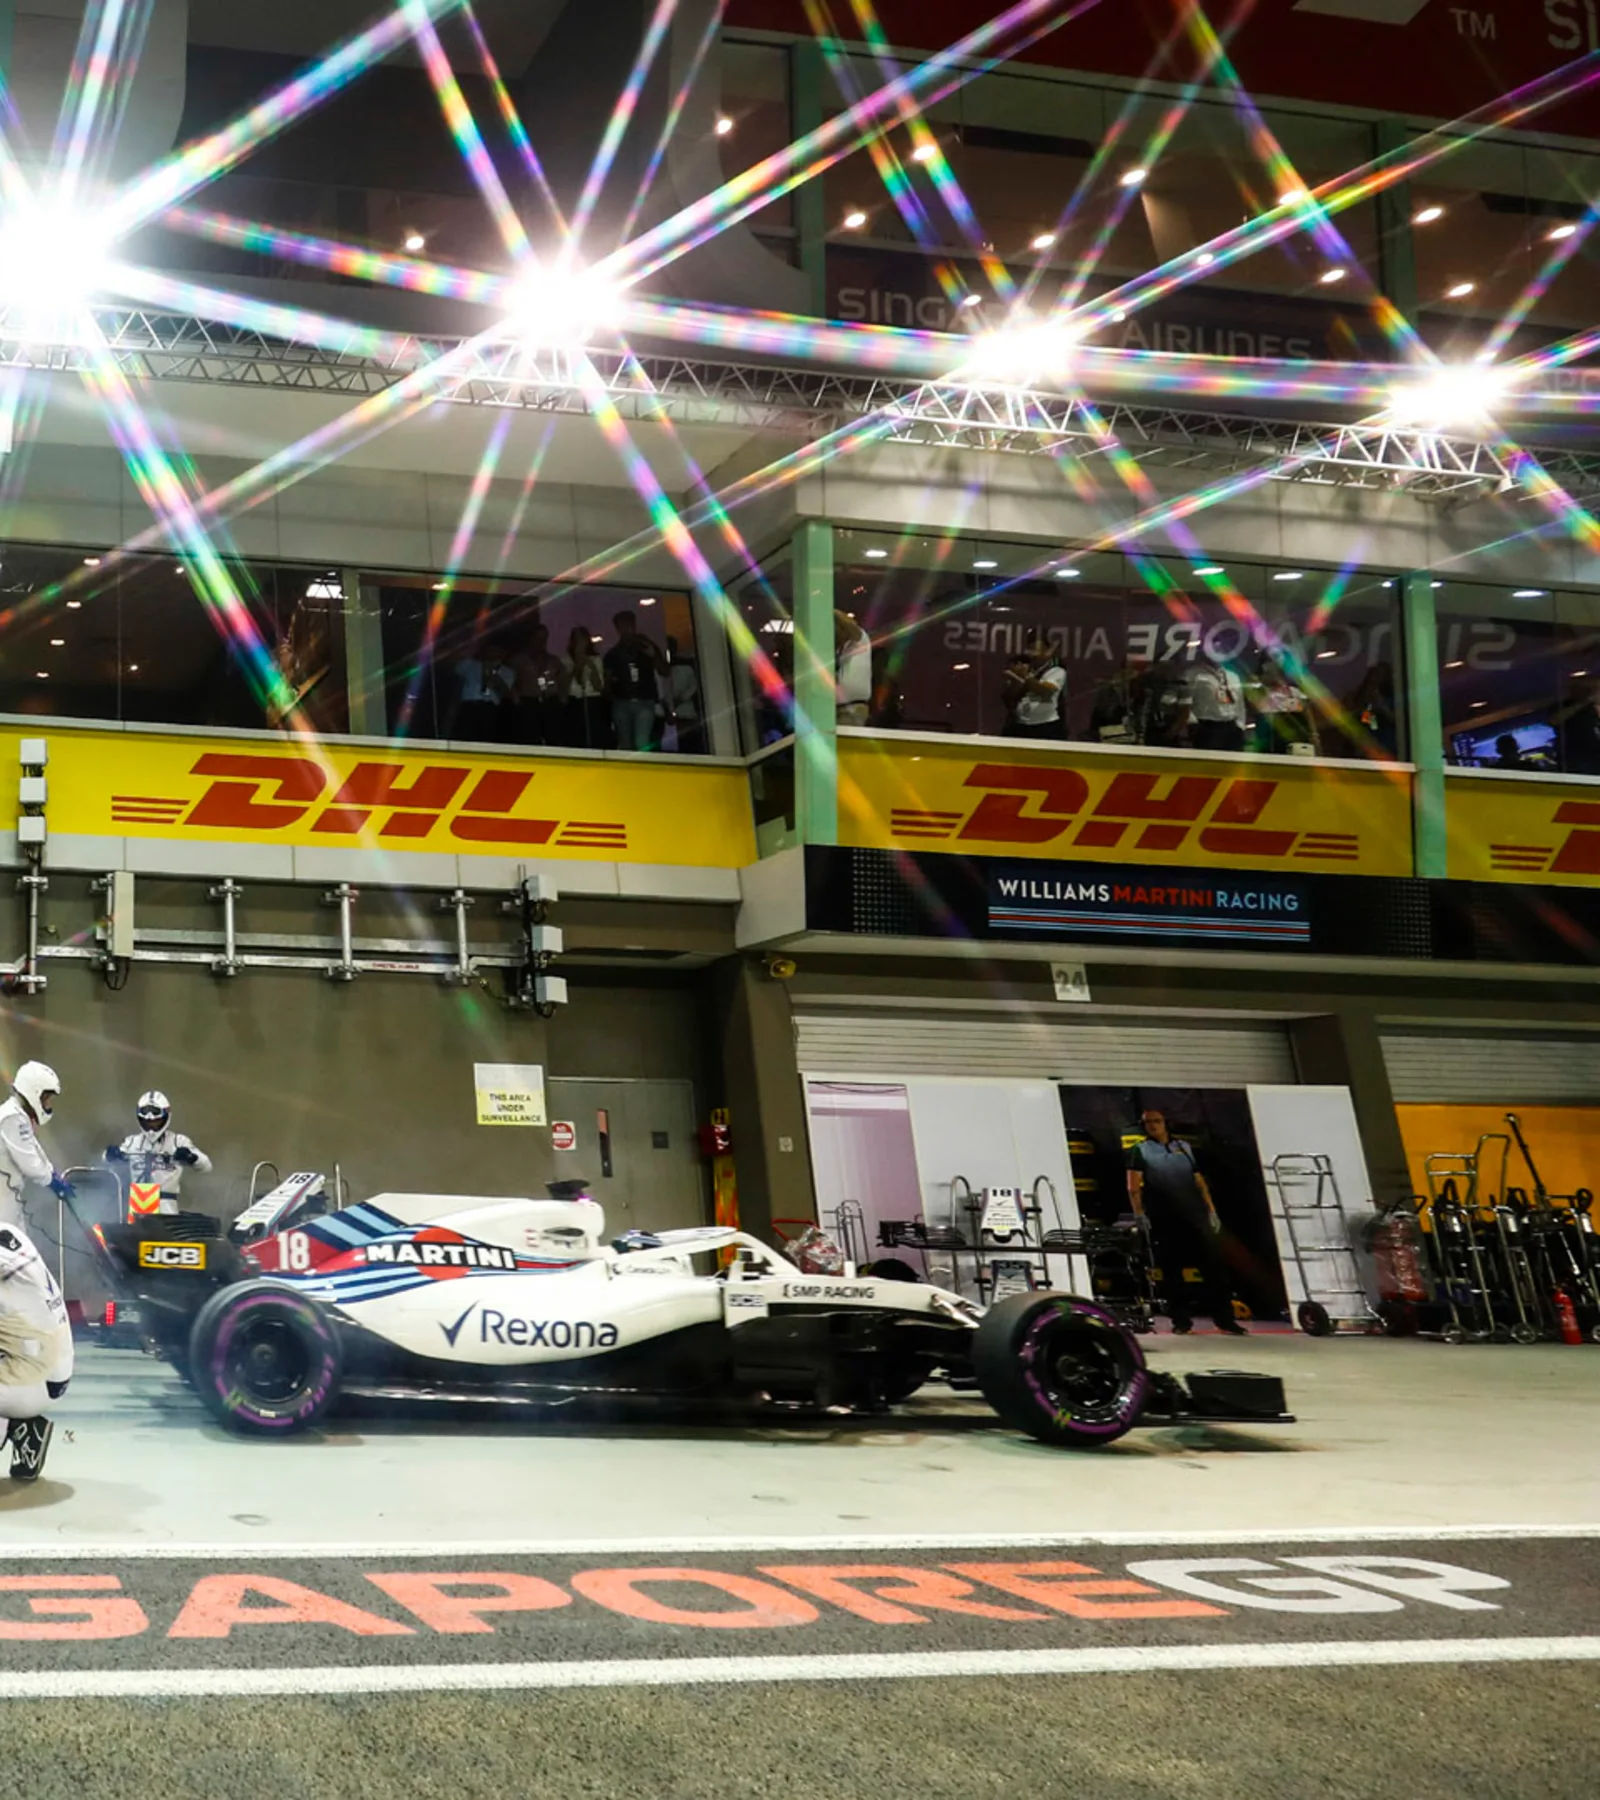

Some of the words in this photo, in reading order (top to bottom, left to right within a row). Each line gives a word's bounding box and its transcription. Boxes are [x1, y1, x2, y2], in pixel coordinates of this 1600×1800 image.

[1449, 8, 1496, 40] TM
[182, 752, 561, 845] DHL
[954, 763, 1301, 857] DHL
[998, 878, 1110, 902] WILLIAMS
[1112, 884, 1212, 908] MARTINI
[1215, 890, 1299, 911] RACING
[1055, 969, 1088, 994] 24
[489, 1092, 507, 1101] THIS
[497, 1104, 525, 1112] UNDER
[288, 1174, 311, 1184] 18
[144, 1246, 201, 1265] JCB
[277, 1232, 310, 1270] 18
[366, 1244, 516, 1270] MARTINI
[792, 1285, 821, 1297] SMP
[823, 1286, 875, 1299] RACING
[480, 1309, 619, 1348] Rexona
